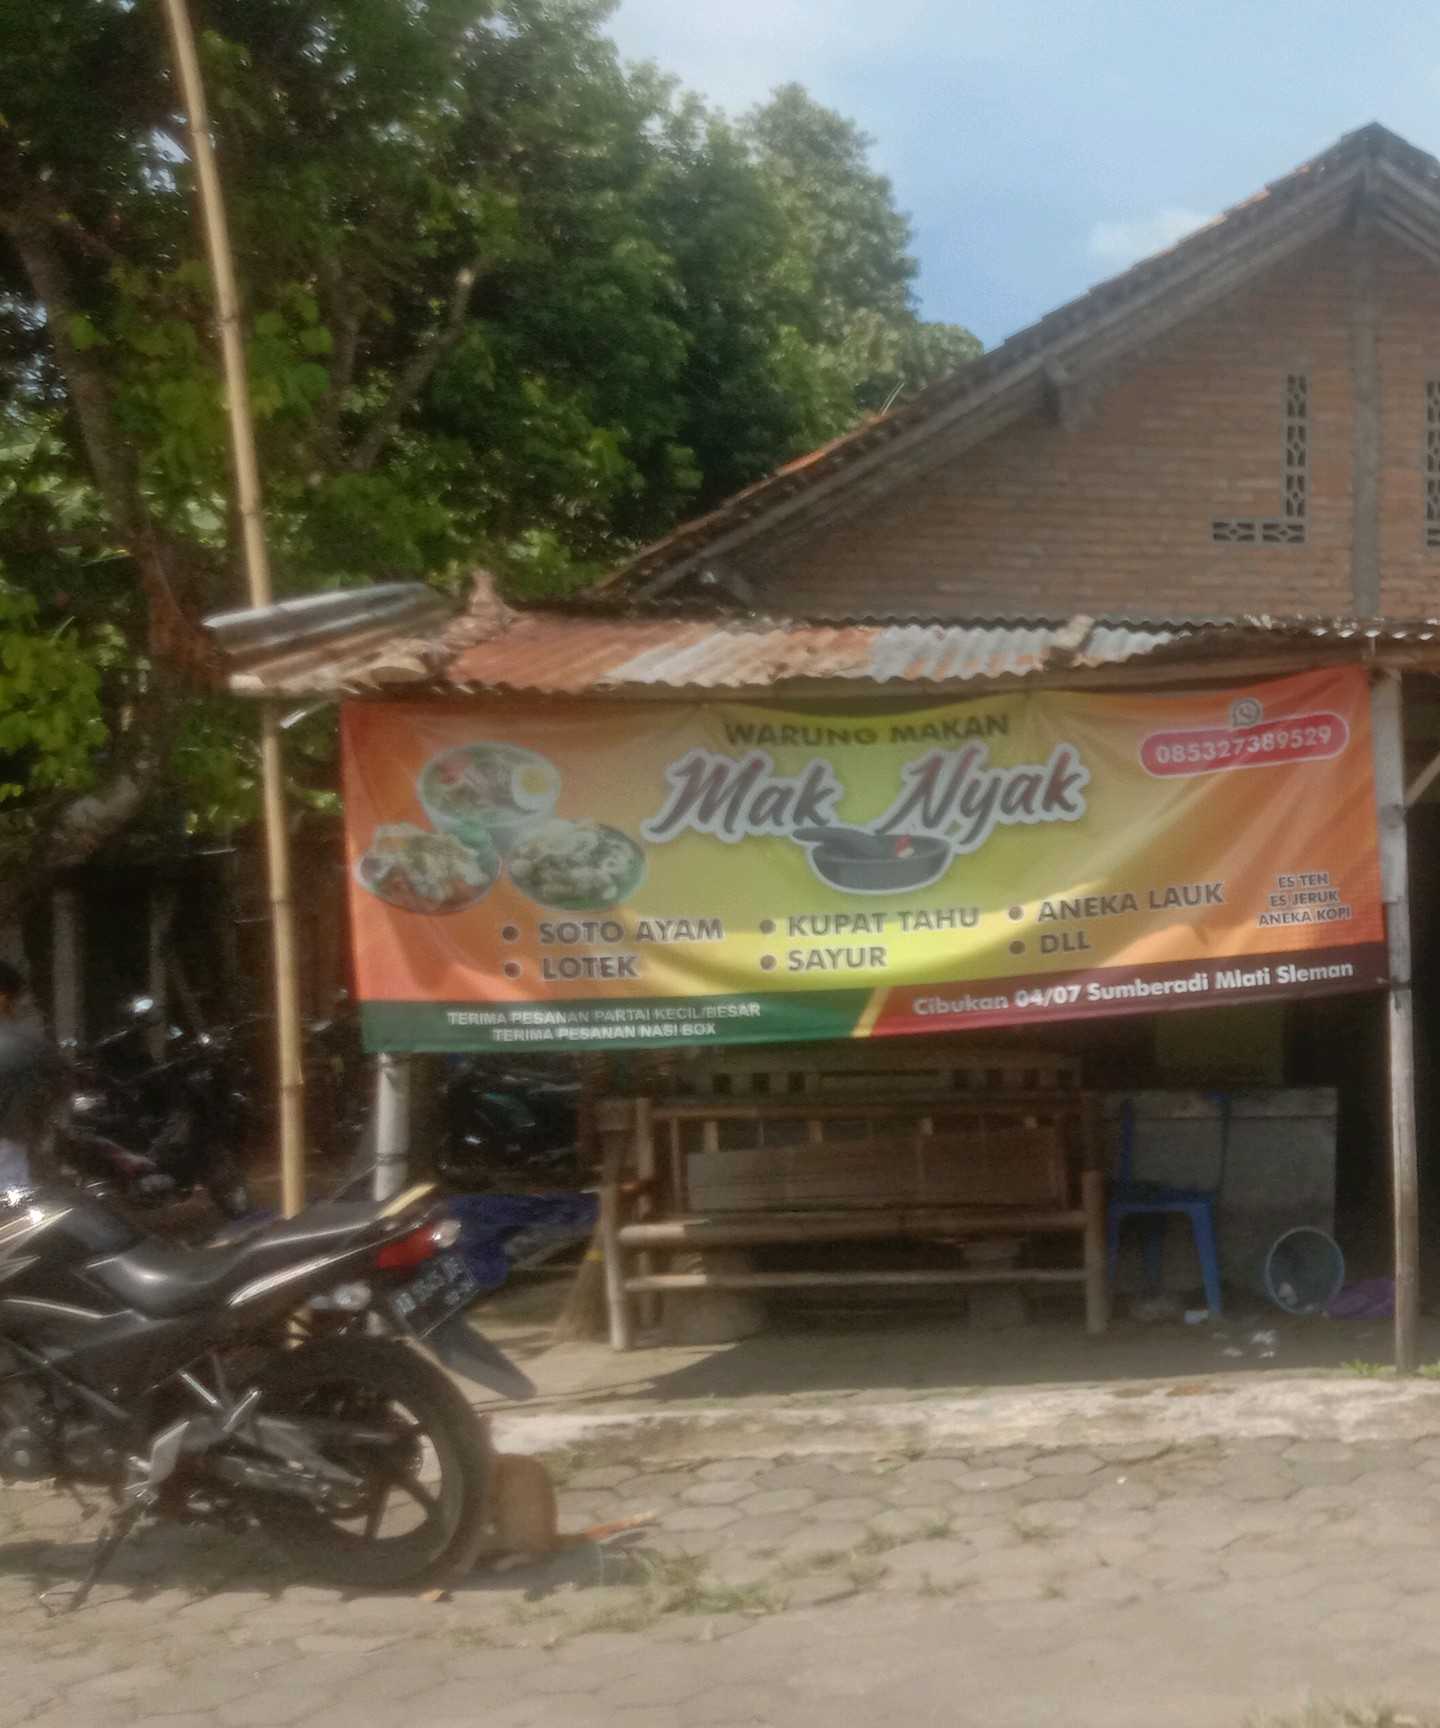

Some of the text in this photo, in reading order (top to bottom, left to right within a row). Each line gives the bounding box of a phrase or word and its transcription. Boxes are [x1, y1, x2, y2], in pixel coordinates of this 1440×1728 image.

[725, 714, 1010, 747] WARUNG MAKAN
[1155, 724, 1332, 765] 085327389529
[645, 743, 1084, 848] Mak Nyak
[1278, 872, 1329, 888] ES TEH
[1037, 882, 1224, 923] ANEKA LAUK
[1270, 890, 1339, 907] ES JERUK
[787, 907, 980, 937] KUPAT TAHU
[1258, 906, 1350, 926] ANEKA KOPI
[538, 918, 724, 945] SOTO AYAM
[1039, 932, 1091, 955] DLL
[542, 955, 640, 980] LOTEK
[787, 947, 886, 971] SAYUR
[913, 960, 1353, 1017] Cibukan 04/07 Sumberadi Mlati Sleman
[447, 1011, 507, 1025] TERIMA
[511, 1009, 590, 1025] PESANAN
[594, 1008, 651, 1022] PARTAI
[493, 1022, 716, 1041] TERIMA PESANAN NASI BOX
